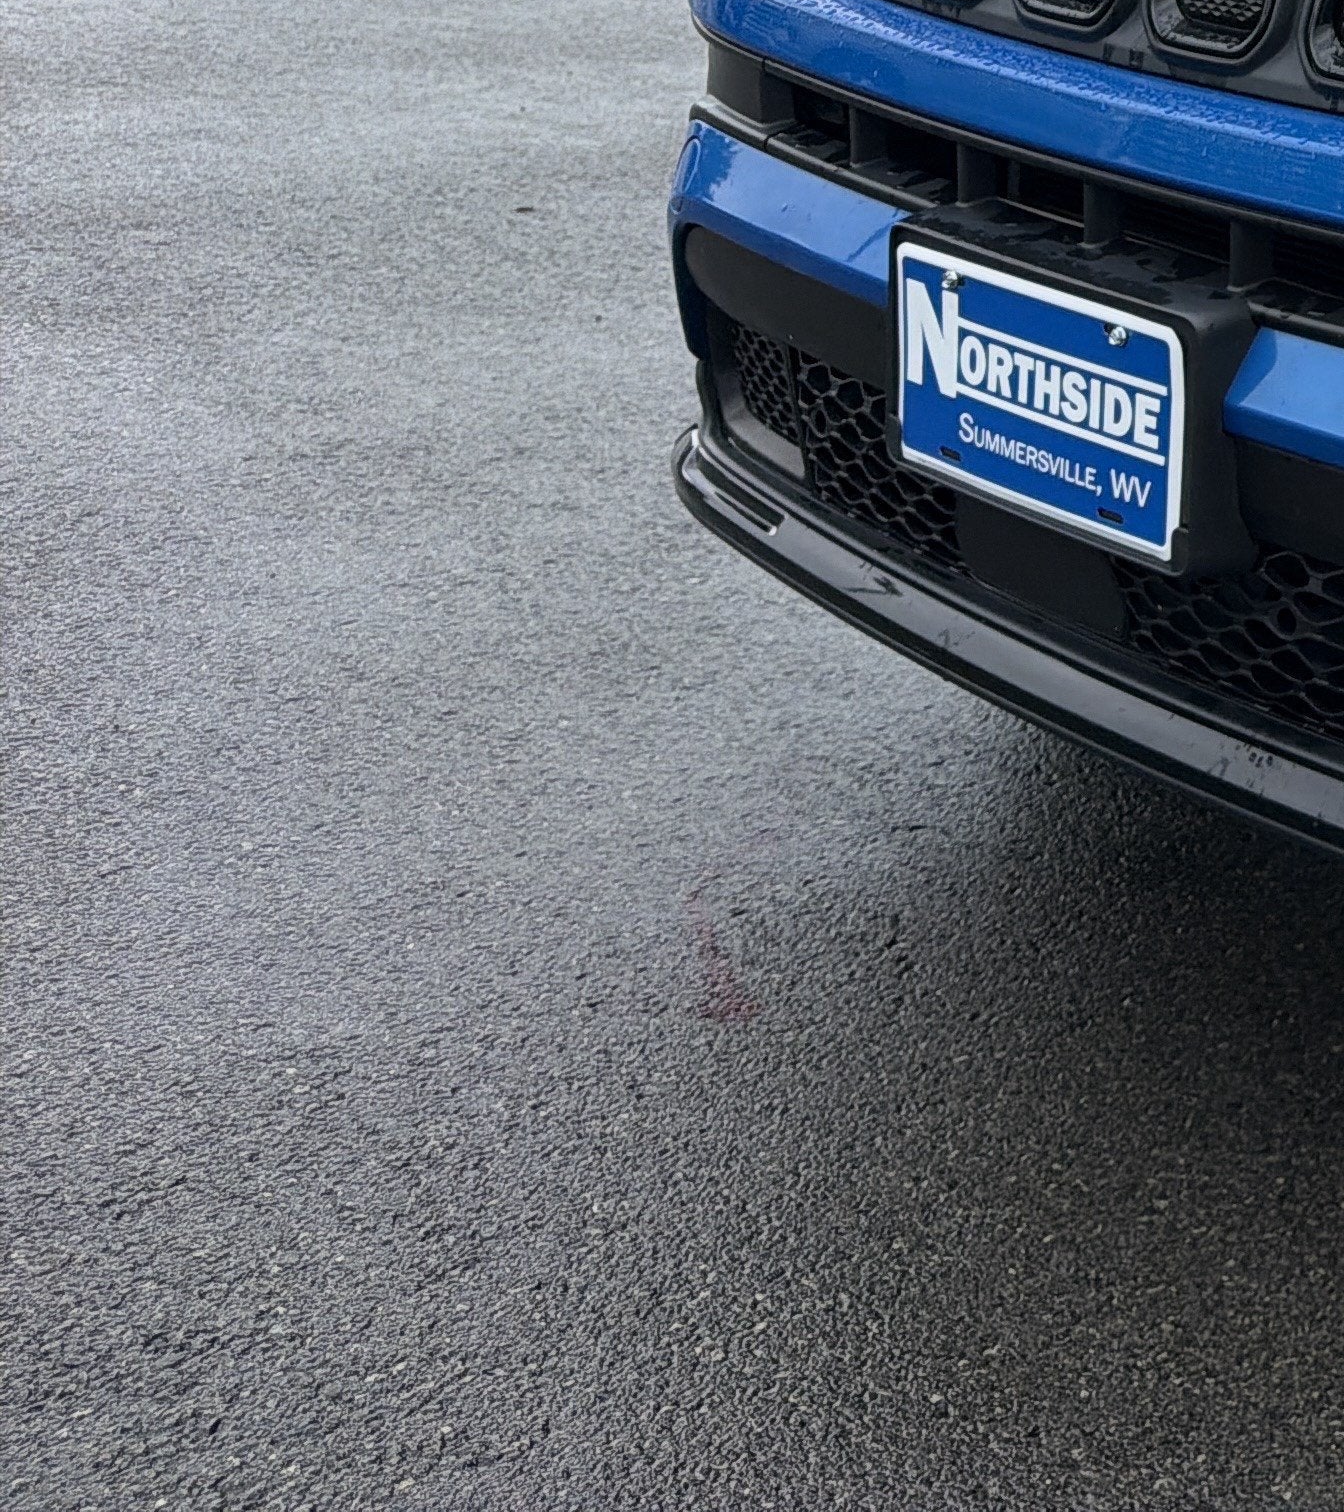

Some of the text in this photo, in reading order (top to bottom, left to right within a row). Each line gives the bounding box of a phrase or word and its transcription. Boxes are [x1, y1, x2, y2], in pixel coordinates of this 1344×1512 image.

[906, 278, 1162, 450] NORTHSIDE
[957, 412, 1152, 508] SUMMERSVILLE, WV
